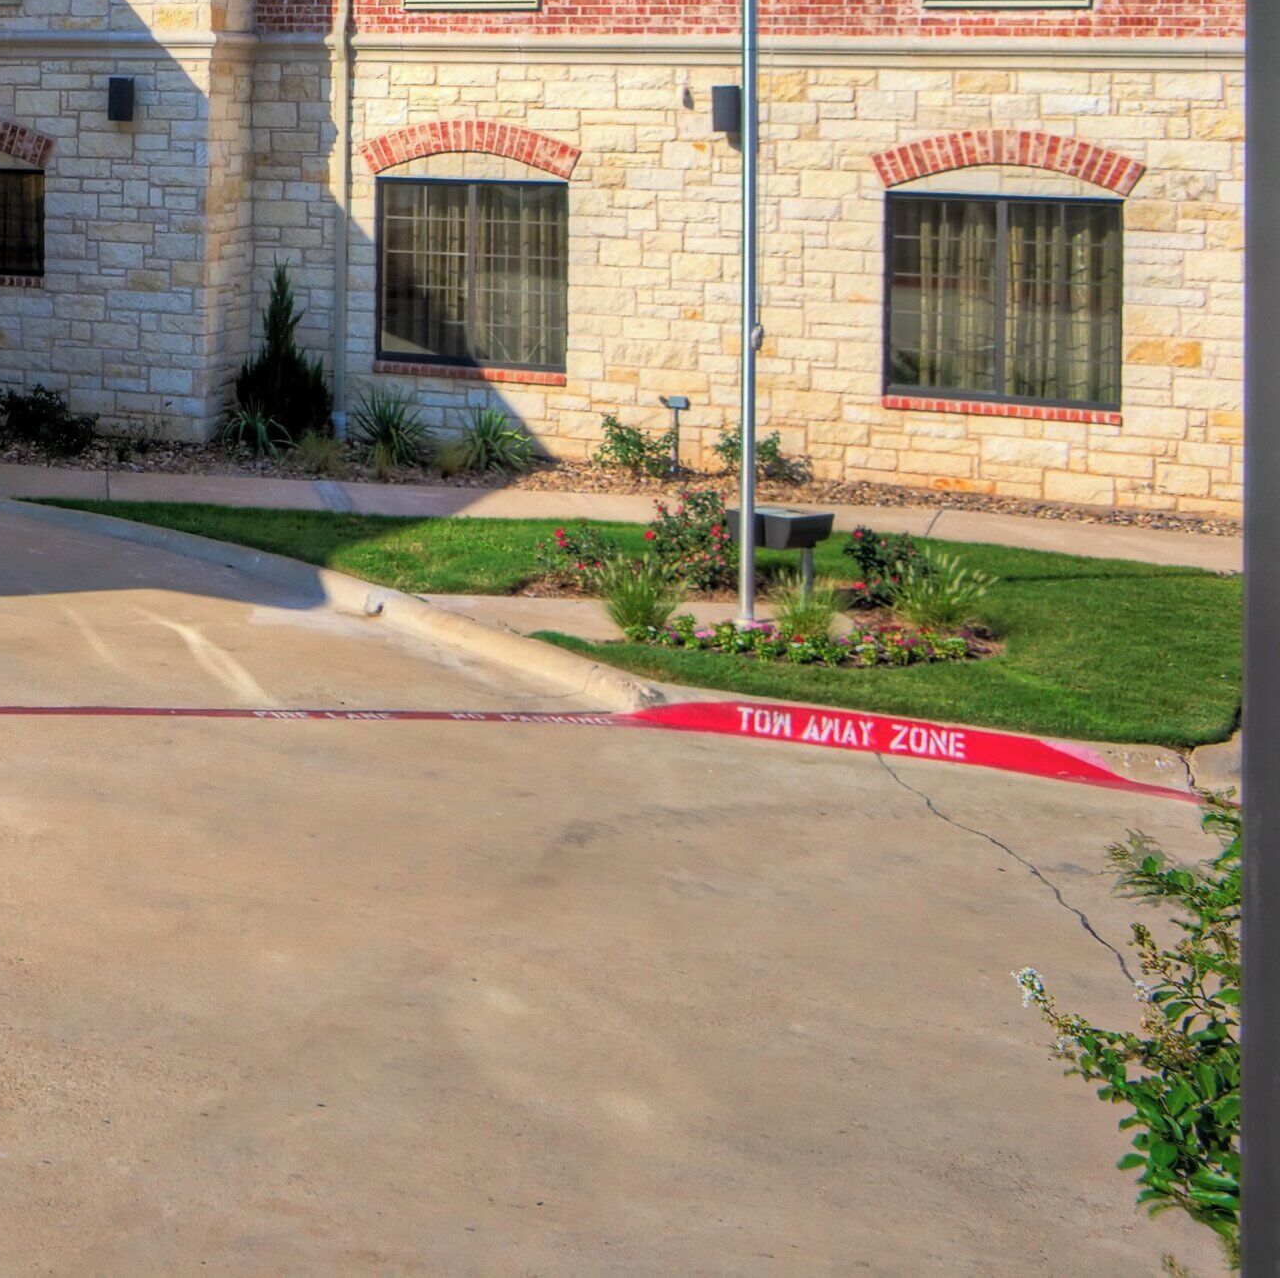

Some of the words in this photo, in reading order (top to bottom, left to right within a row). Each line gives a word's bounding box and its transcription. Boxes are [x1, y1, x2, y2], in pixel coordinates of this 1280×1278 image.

[737, 706, 792, 736] TOW
[801, 714, 875, 748] AWAY
[889, 724, 967, 760] ZONE
